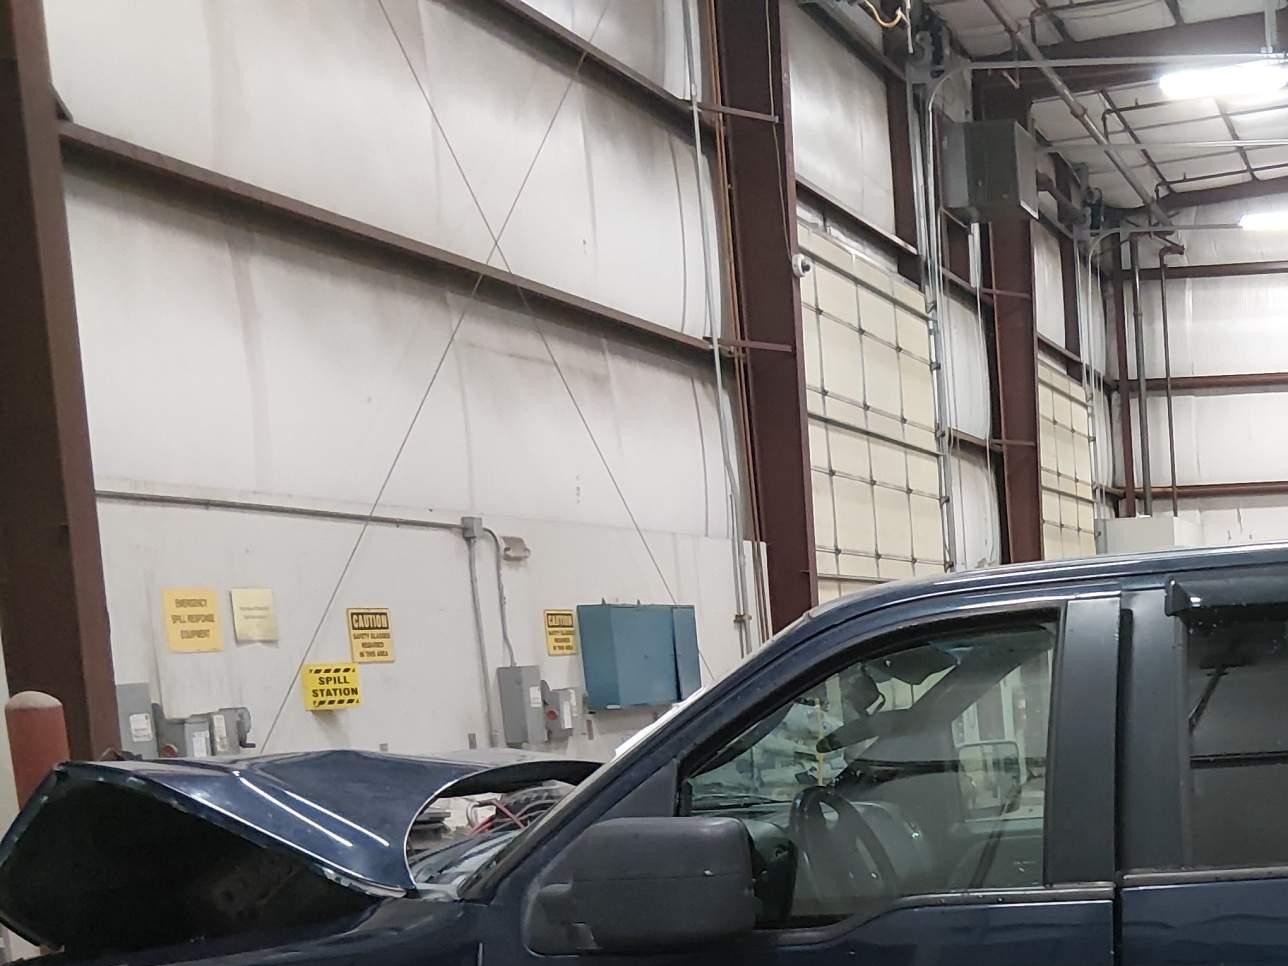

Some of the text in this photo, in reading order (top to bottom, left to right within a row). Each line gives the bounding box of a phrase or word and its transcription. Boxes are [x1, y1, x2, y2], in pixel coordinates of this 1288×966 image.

[352, 614, 388, 628] CAUTION
[318, 676, 350, 685] SPILL
[312, 687, 358, 697] STATION
